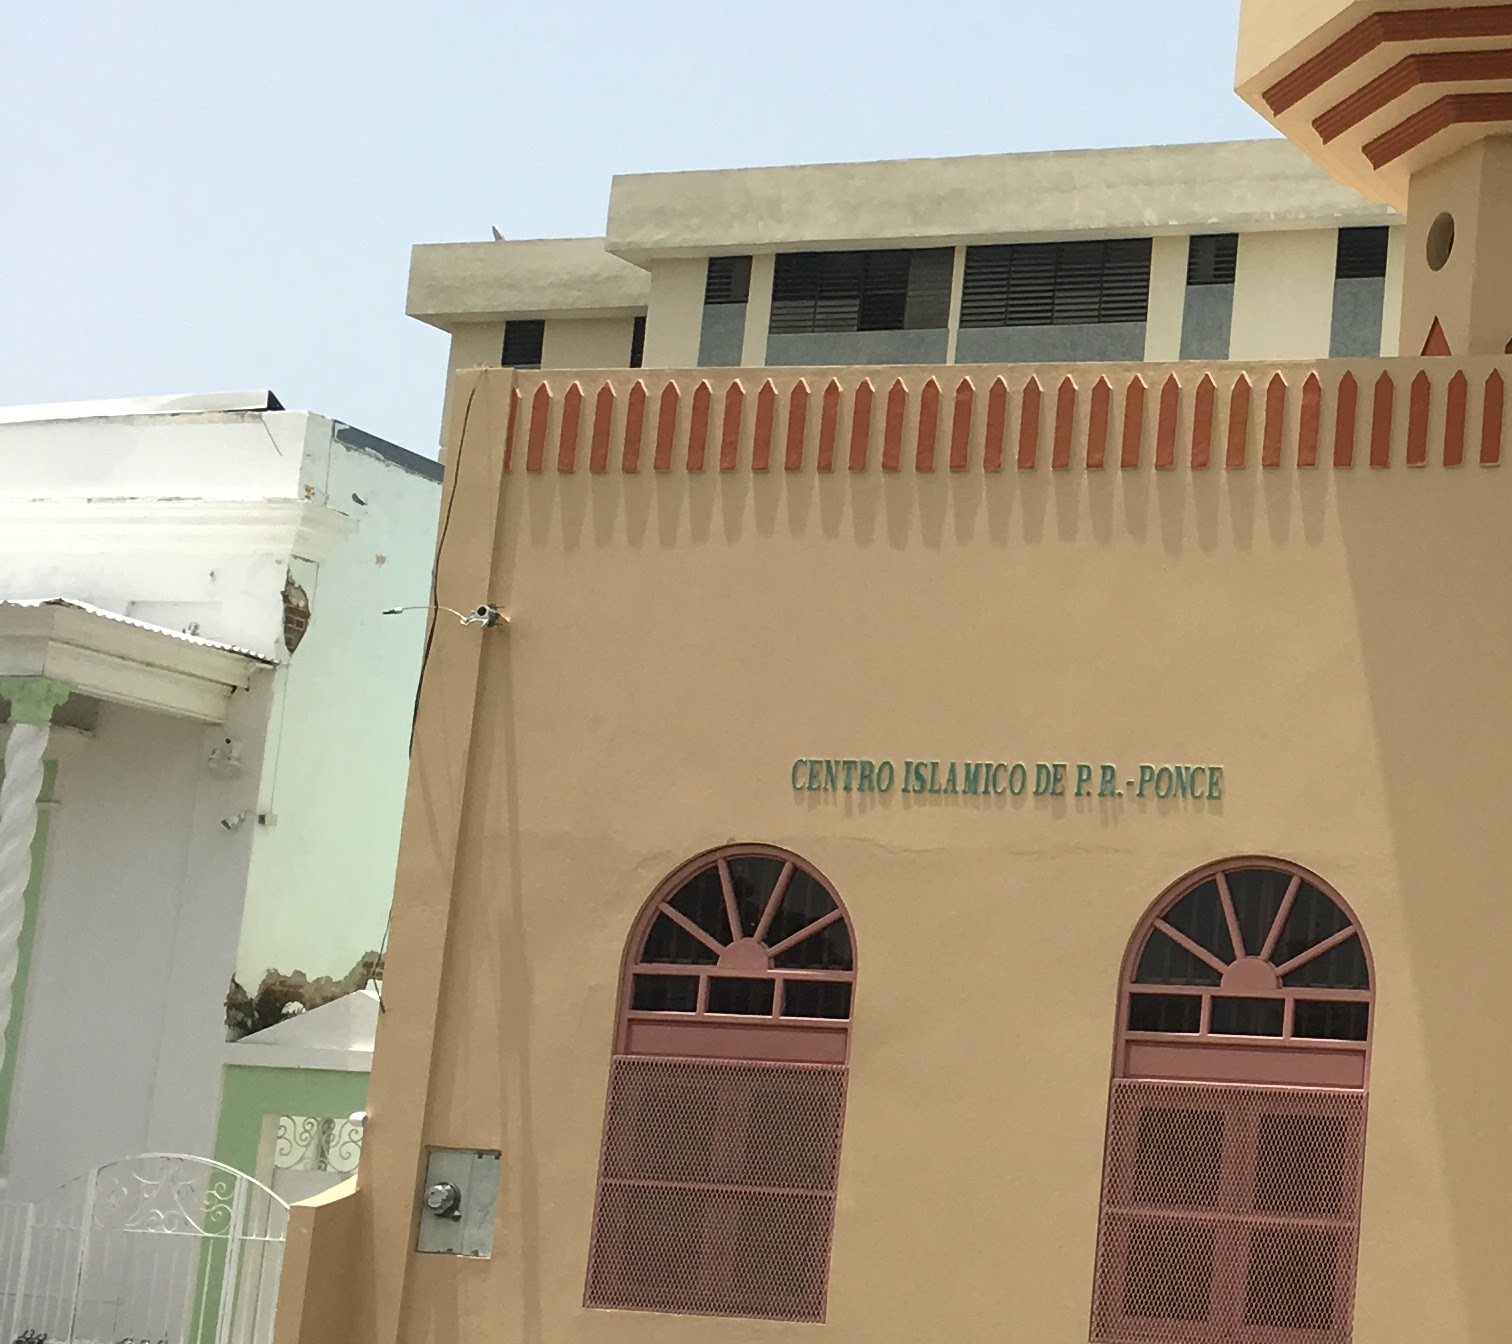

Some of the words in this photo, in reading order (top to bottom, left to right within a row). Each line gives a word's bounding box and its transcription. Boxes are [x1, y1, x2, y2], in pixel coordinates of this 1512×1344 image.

[791, 758, 894, 793] CENTRO
[901, 760, 1027, 796] ISLAMICO
[1033, 762, 1067, 796] DE
